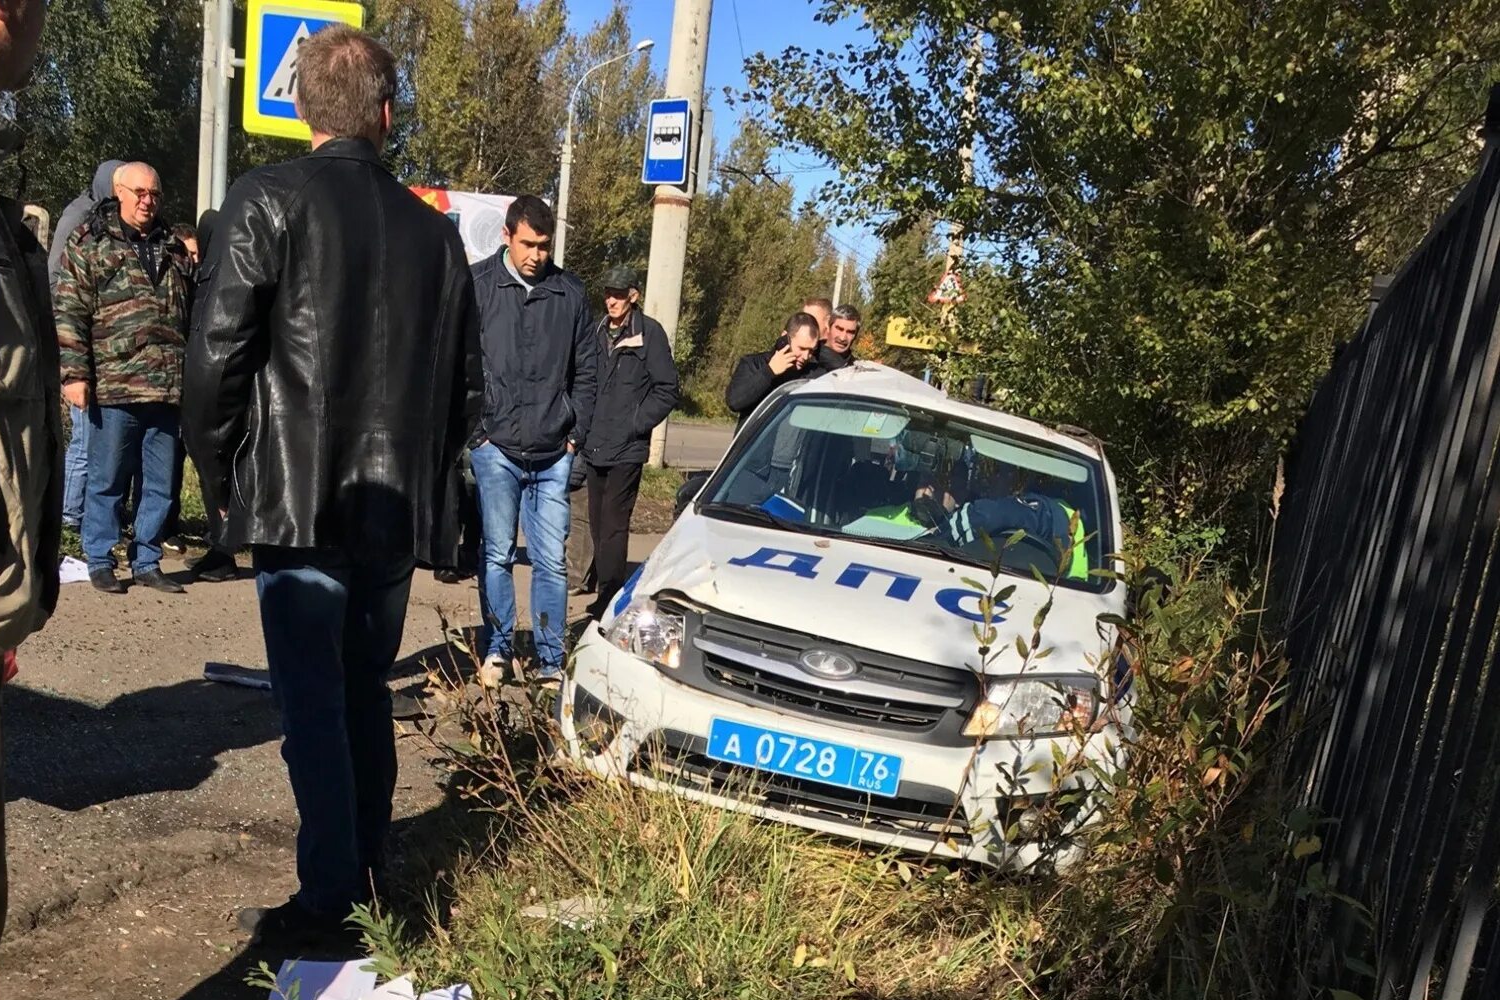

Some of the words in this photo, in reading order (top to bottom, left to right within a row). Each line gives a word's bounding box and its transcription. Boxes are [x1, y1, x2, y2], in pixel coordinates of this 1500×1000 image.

[727, 547, 1007, 624] ДПС
[756, 733, 837, 778] 0728
[860, 751, 889, 780] 76
[857, 776, 882, 790] RUS
